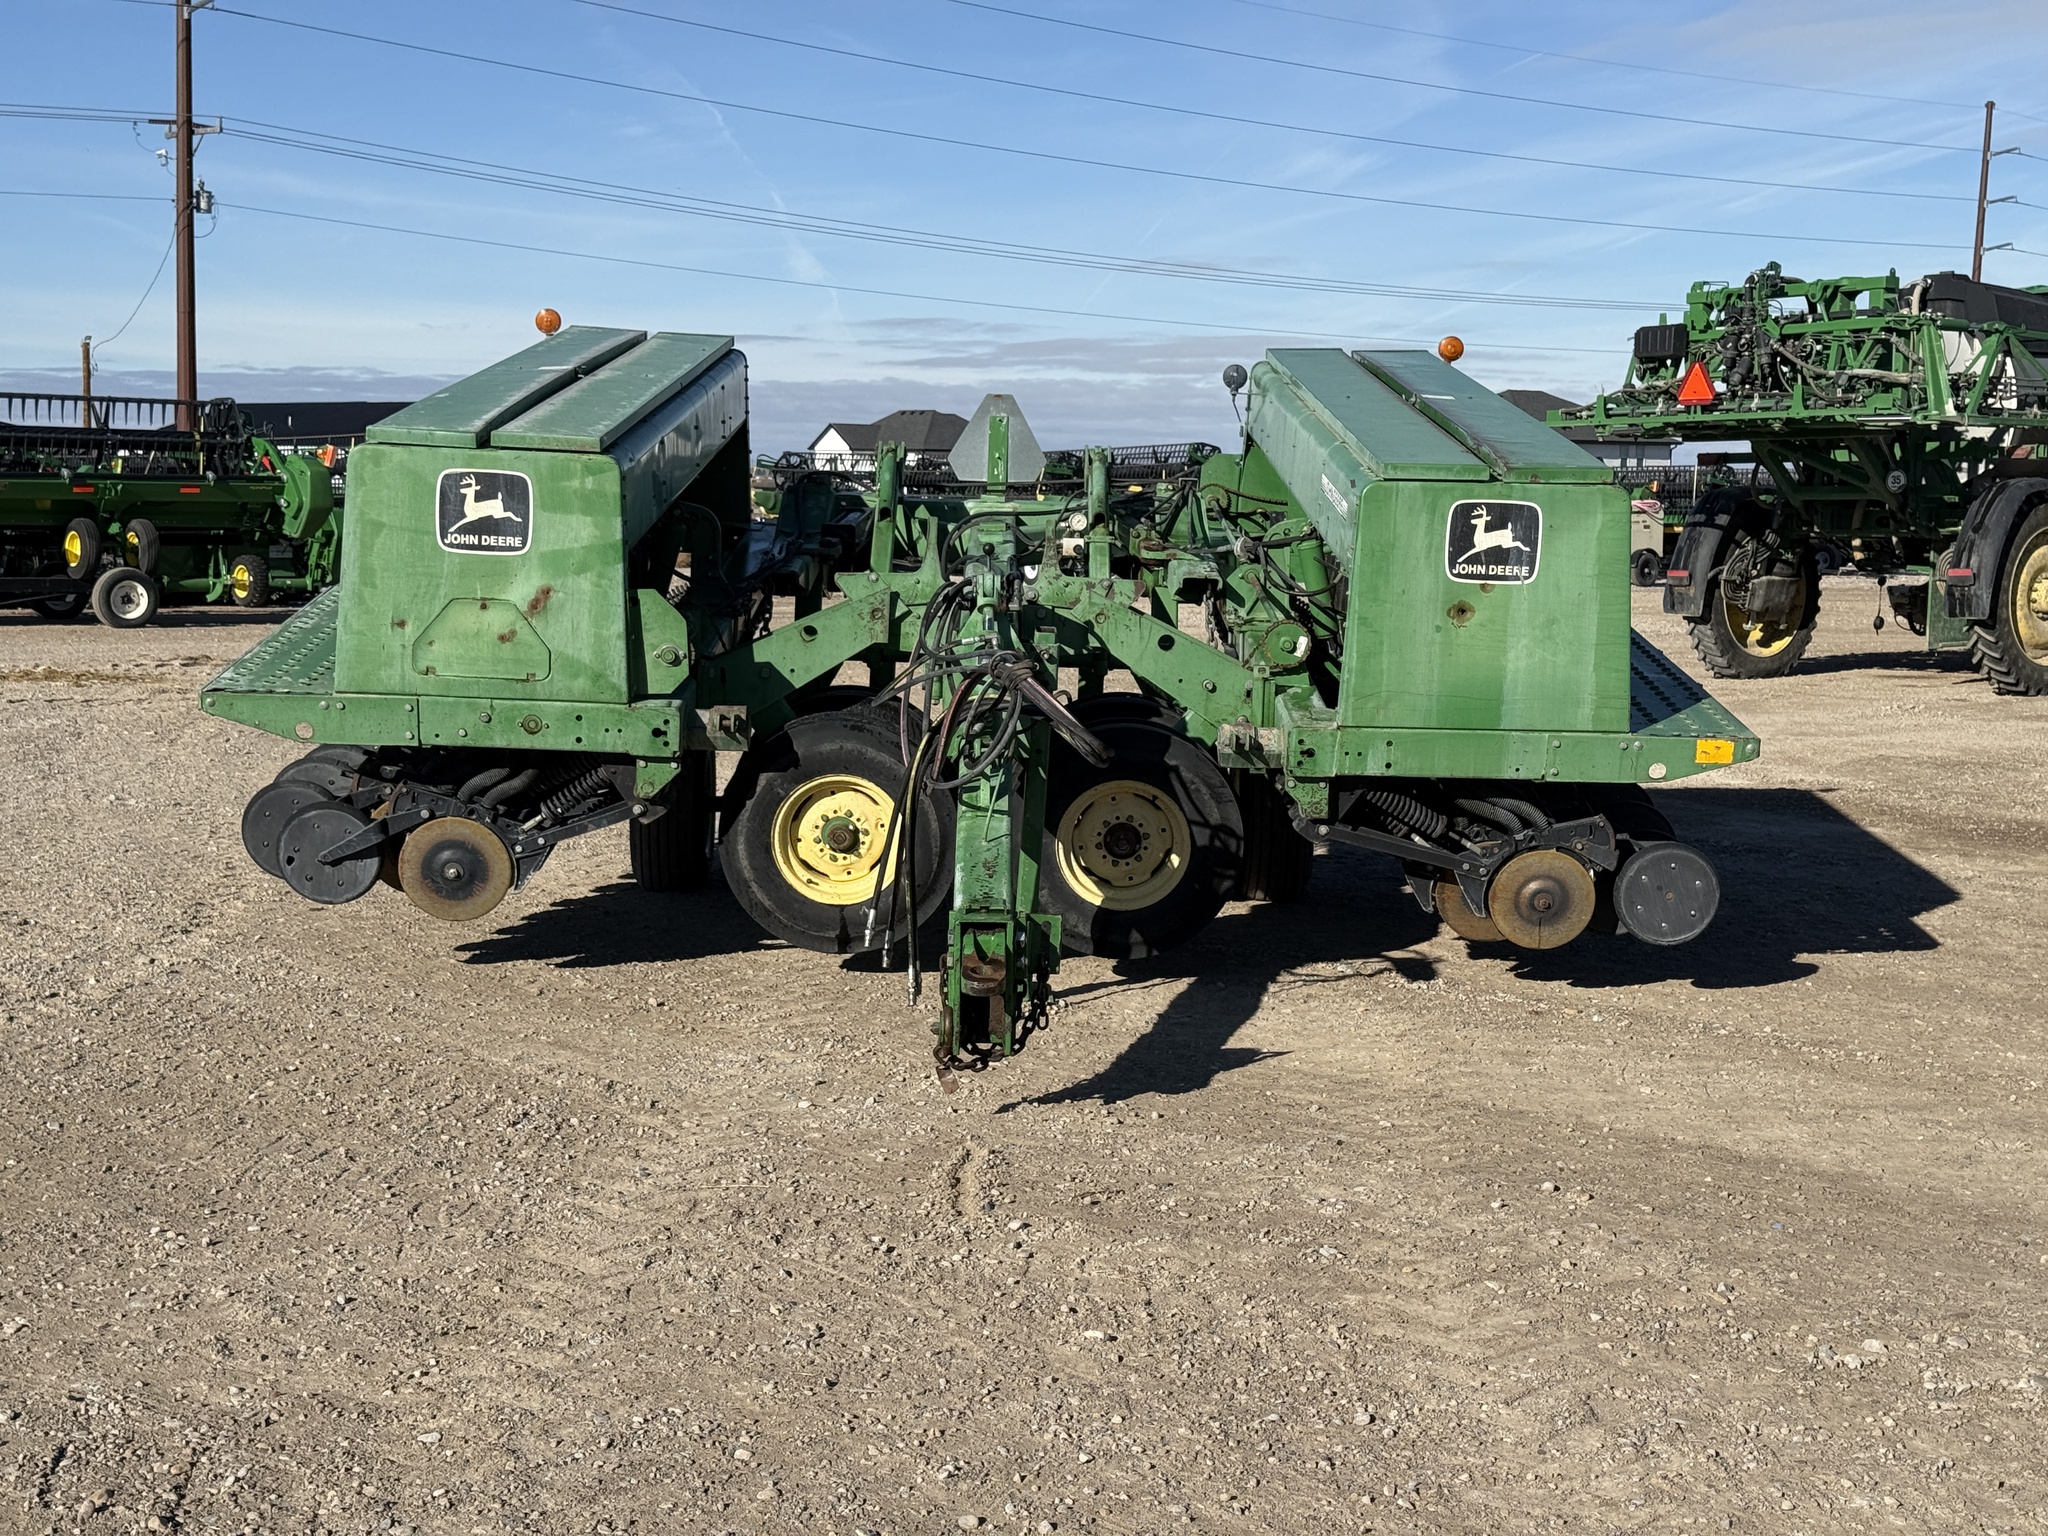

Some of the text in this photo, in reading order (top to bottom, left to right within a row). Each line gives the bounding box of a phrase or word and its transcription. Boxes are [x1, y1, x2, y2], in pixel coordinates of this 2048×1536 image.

[1891, 475, 1901, 485] 35
[444, 533, 522, 547] JOHN DEERE
[1452, 563, 1529, 577] JOHN DEERE
